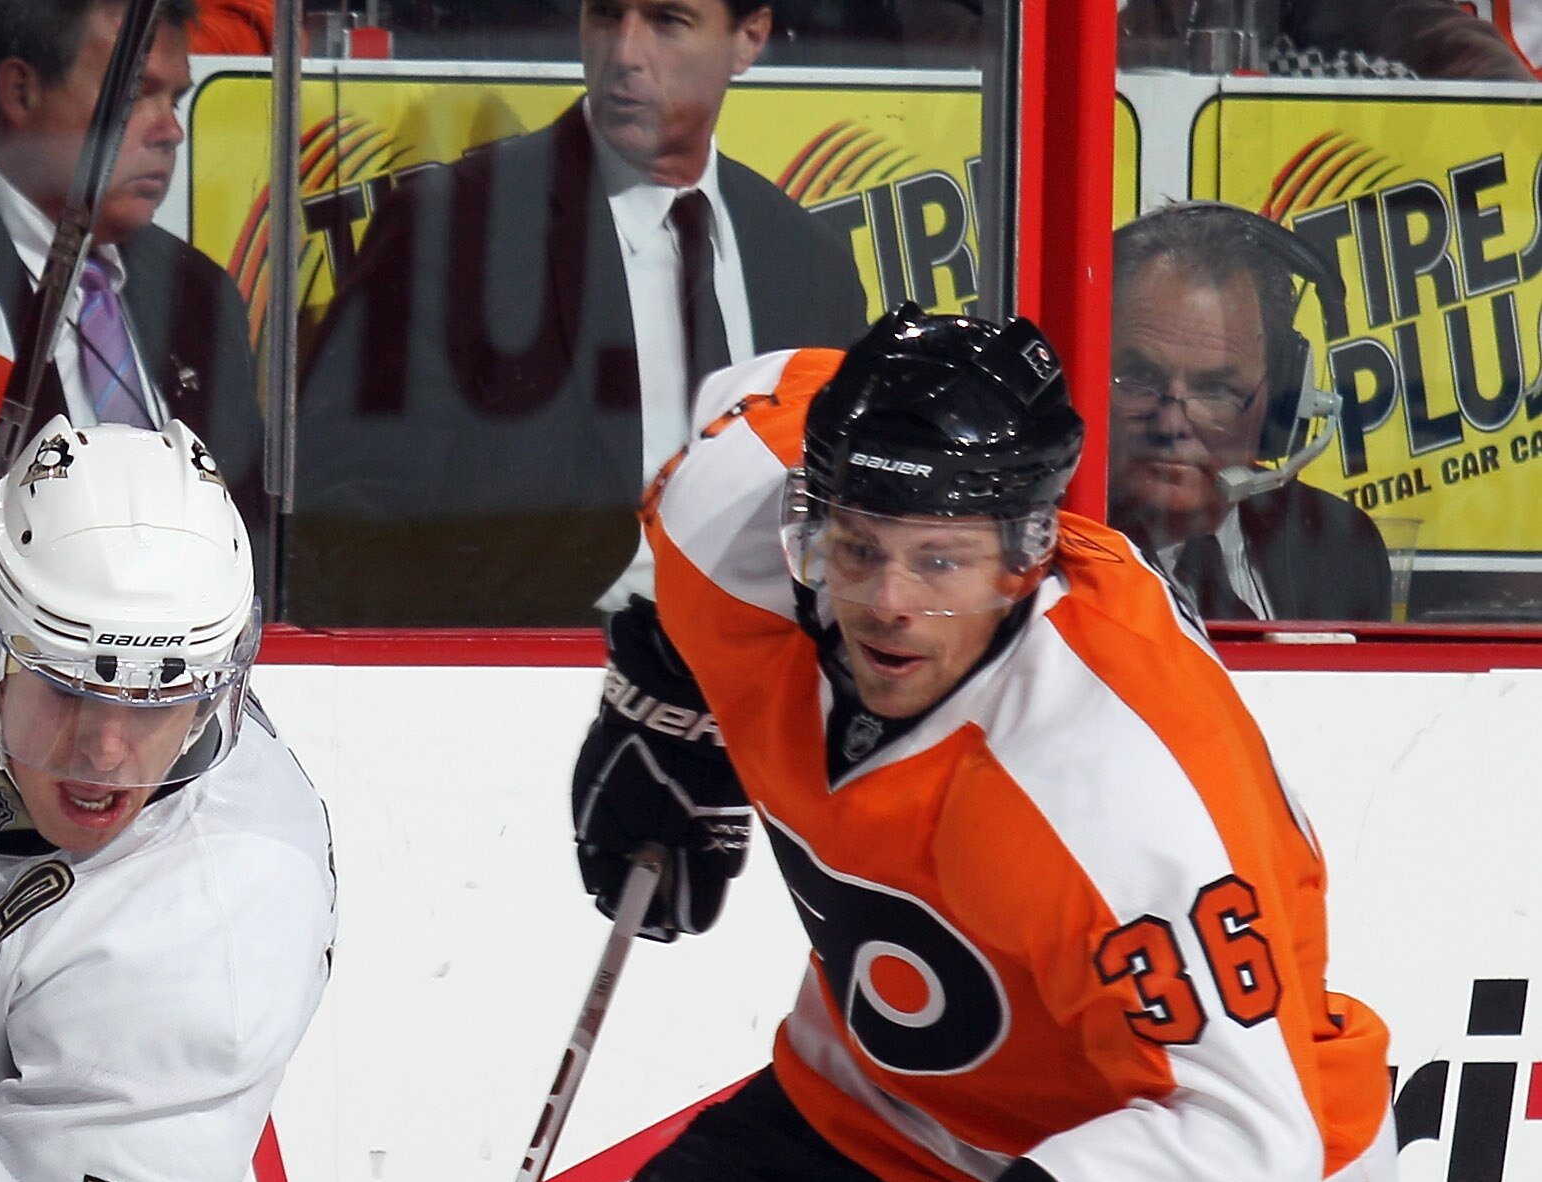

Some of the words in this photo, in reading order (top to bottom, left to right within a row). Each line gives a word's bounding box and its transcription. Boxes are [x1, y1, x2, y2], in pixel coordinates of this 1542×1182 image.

[807, 158, 981, 317] TIR
[849, 452, 933, 479] BAUER
[1343, 466, 1433, 511] TOTAL
[1441, 445, 1500, 485] CAR
[96, 633, 186, 649] BAUER
[603, 660, 728, 747] AUER
[1094, 873, 1283, 1045] 36
